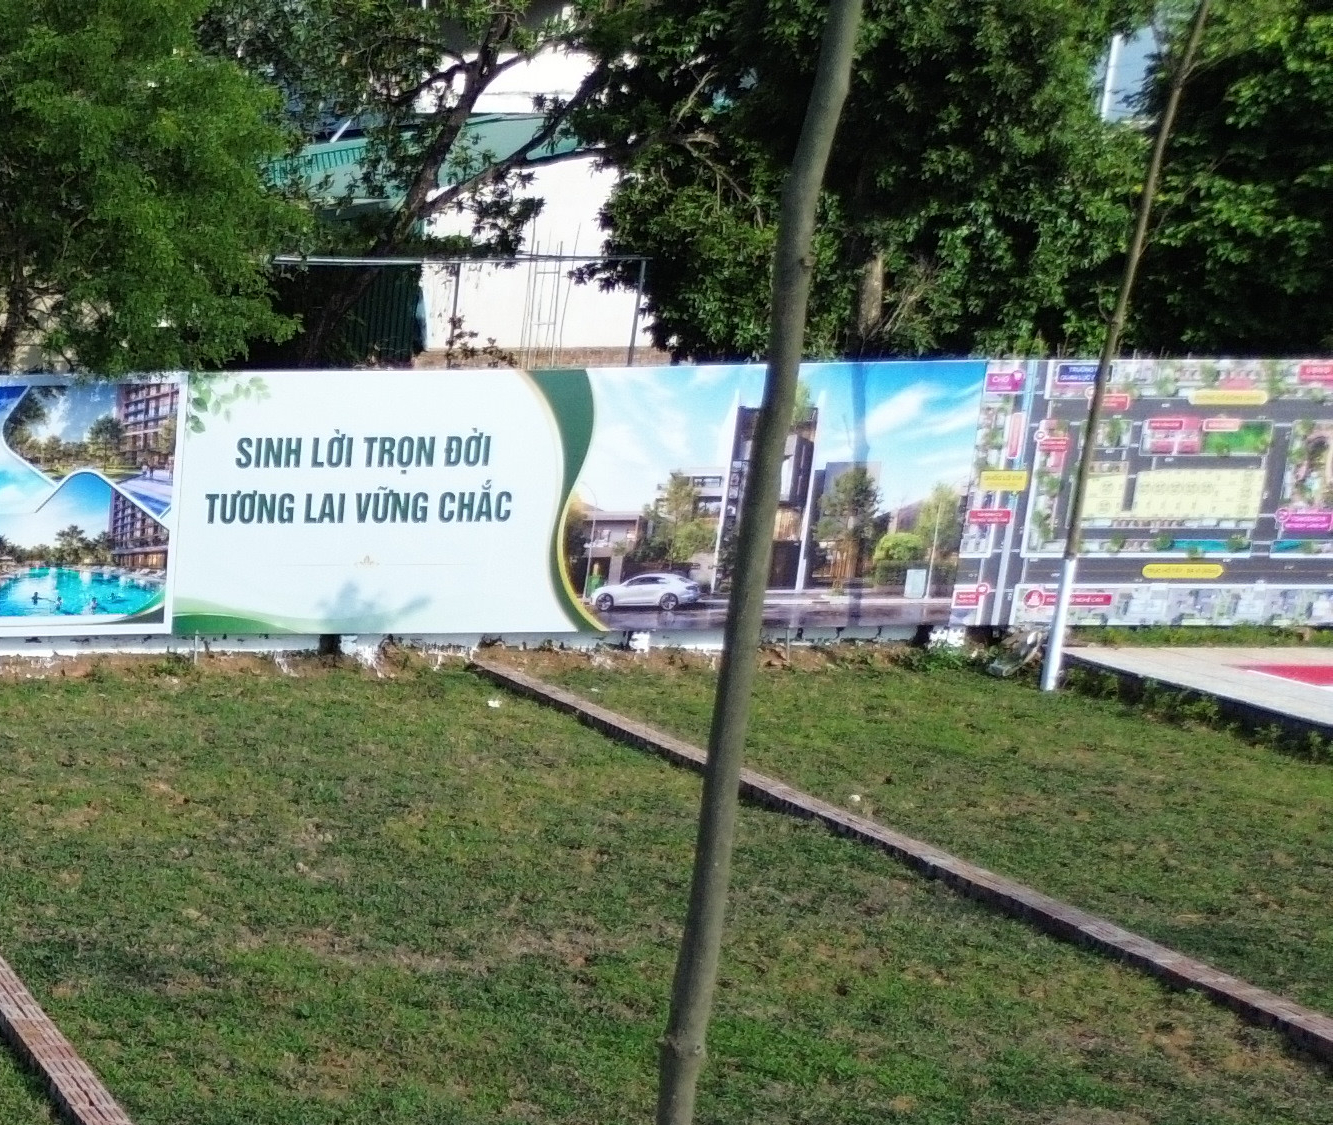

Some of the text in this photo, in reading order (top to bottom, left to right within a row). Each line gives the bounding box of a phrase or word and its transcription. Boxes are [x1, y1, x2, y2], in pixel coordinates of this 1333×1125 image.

[235, 427, 492, 475] SINH LỜI TRỌN ĐỜI
[205, 479, 512, 524] TƯƠNG LAI VỮNG CHẮC
